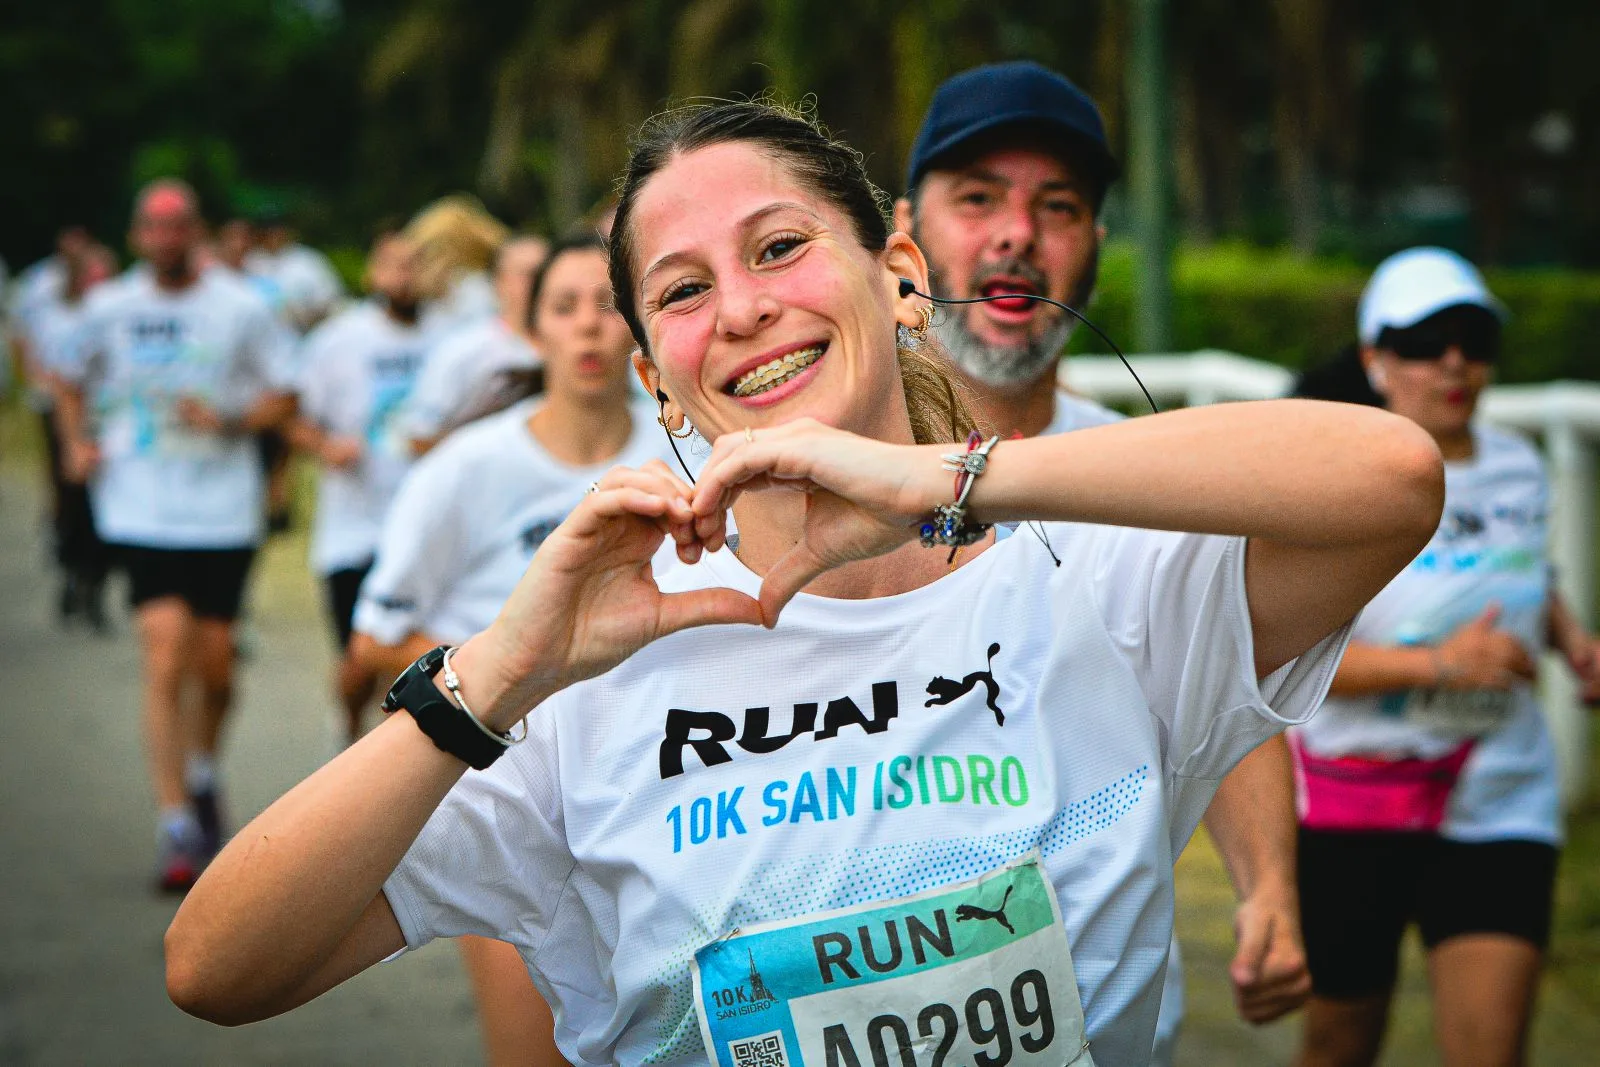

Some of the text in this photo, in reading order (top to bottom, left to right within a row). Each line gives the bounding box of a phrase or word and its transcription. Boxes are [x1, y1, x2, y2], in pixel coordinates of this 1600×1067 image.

[659, 681, 899, 780] RUN
[666, 754, 1030, 854] 10K SAN ISIDRO
[812, 908, 956, 985] RUN
[711, 985, 748, 1008] 10K
[716, 1001, 772, 1021] SAN ISIDRO
